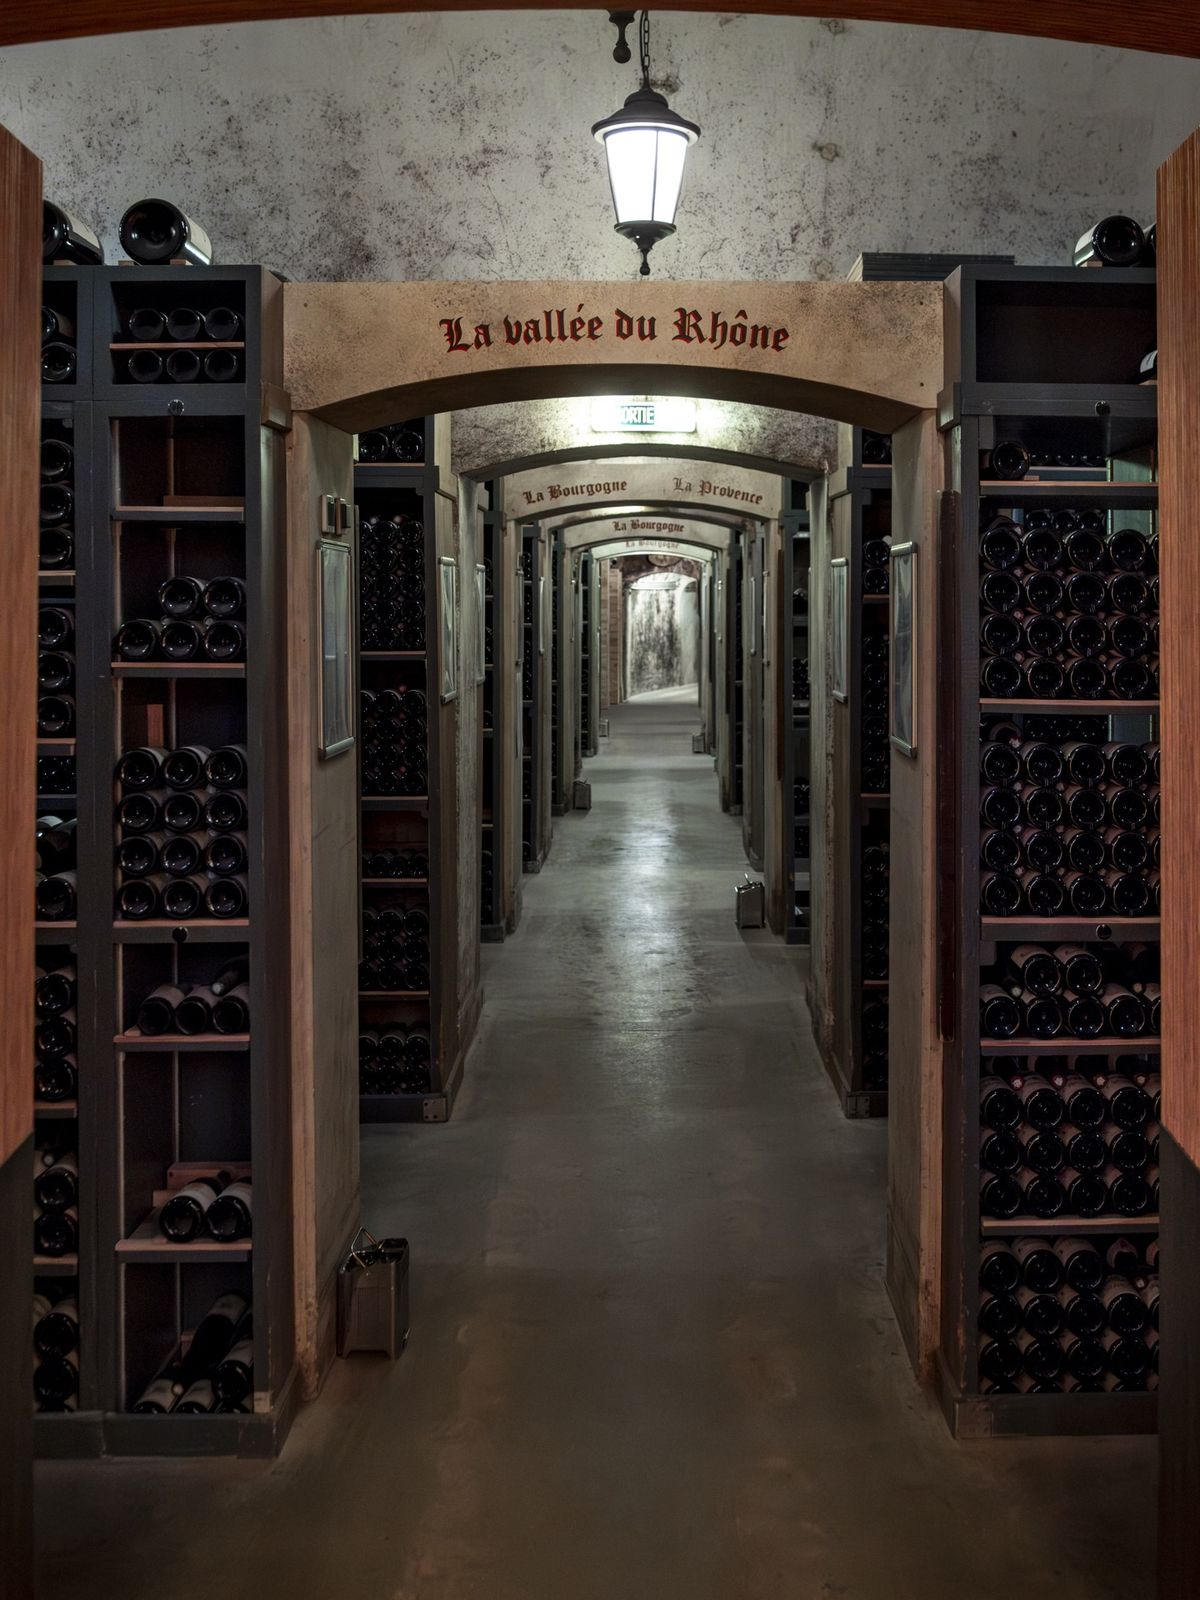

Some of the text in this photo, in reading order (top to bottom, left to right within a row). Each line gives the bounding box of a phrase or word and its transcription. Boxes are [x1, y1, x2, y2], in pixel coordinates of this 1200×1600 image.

[439, 303, 789, 352] La vallée du Rhône
[523, 480, 627, 504] La Bourgogne
[672, 477, 763, 505] La Provence
[613, 519, 685, 532] La Bourgogne
